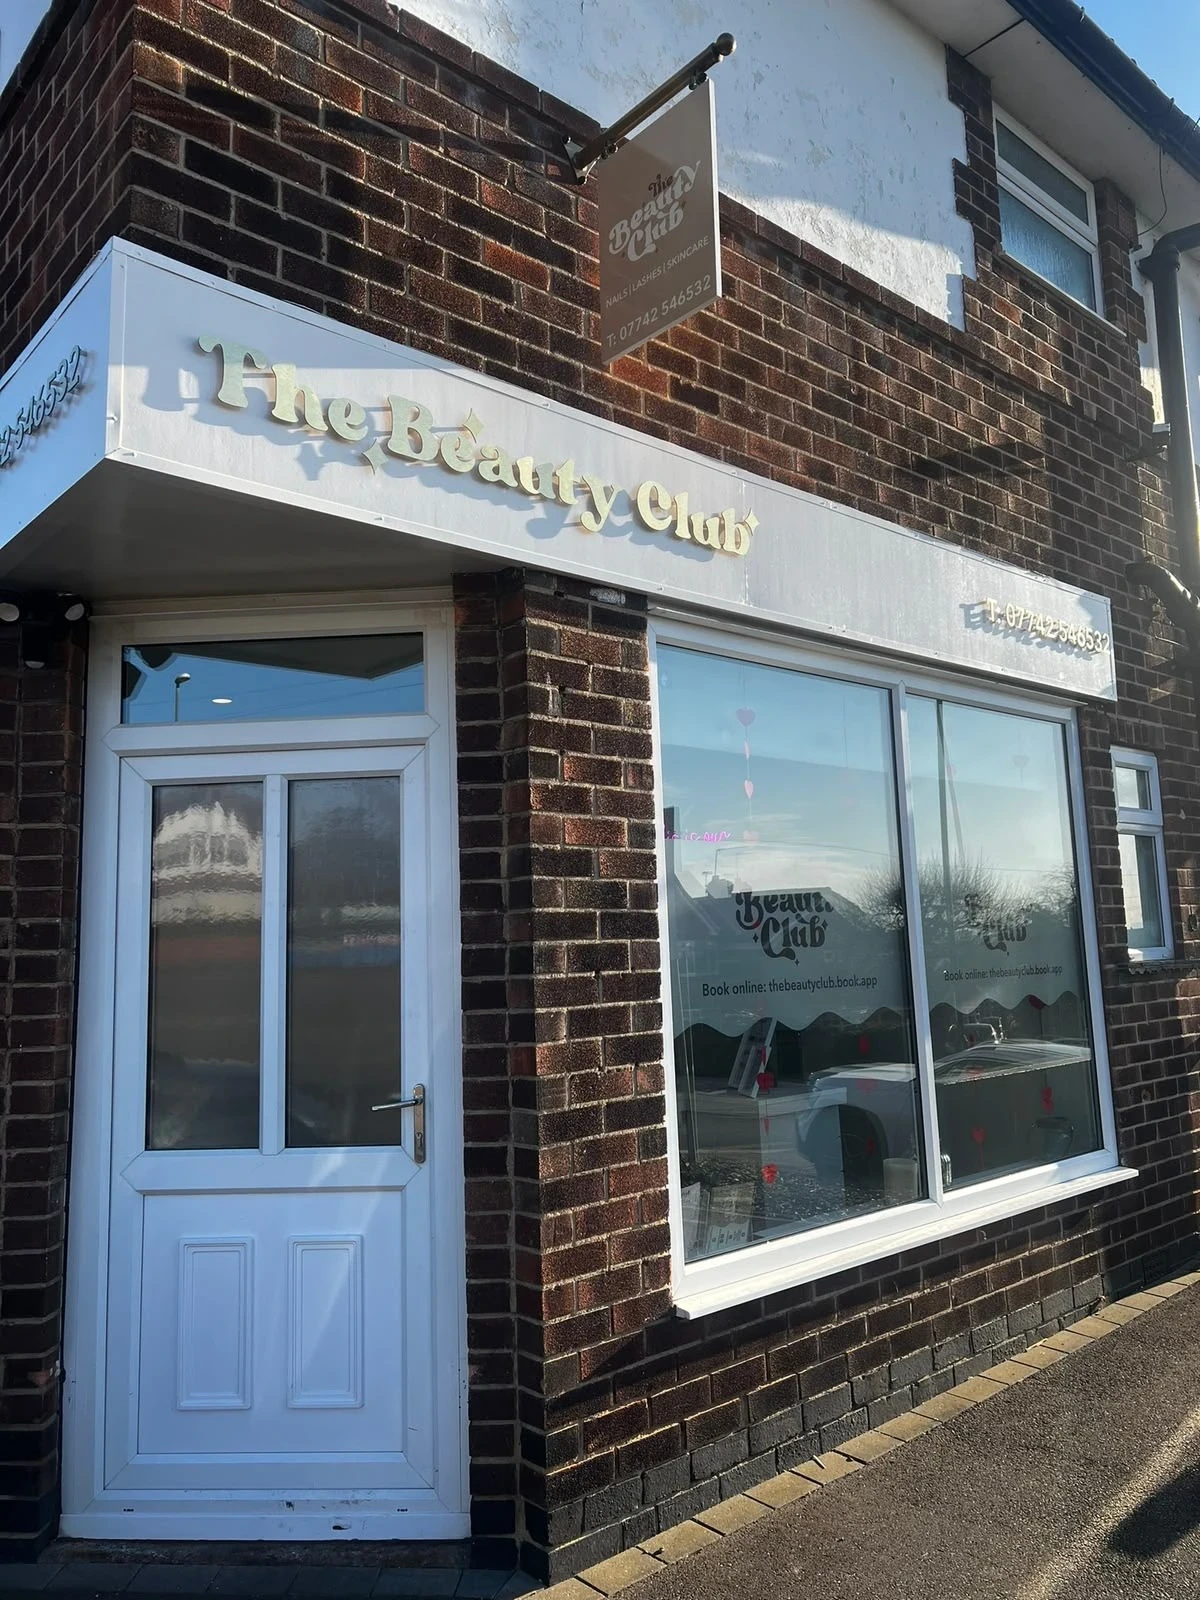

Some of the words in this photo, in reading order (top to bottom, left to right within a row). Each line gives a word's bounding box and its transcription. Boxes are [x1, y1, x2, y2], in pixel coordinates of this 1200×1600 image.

[609, 160, 701, 255] Beauty
[648, 173, 674, 197] The
[627, 201, 684, 262] Club
[606, 288, 629, 308] NAILS
[632, 266, 662, 292] LASHES
[667, 235, 710, 270] SKINCARE
[606, 333, 617, 347] T:
[619, 307, 658, 340] 07742
[661, 275, 712, 315] 546532
[198, 335, 369, 441] The
[386, 394, 621, 532] Beauty
[636, 479, 751, 556] Club
[761, 912, 826, 960] Club
[702, 982, 730, 997] Book
[732, 980, 767, 995] online:
[768, 975, 878, 993] thebeautyclub.book.app
[943, 970, 963, 981] Book
[965, 968, 989, 980] online:
